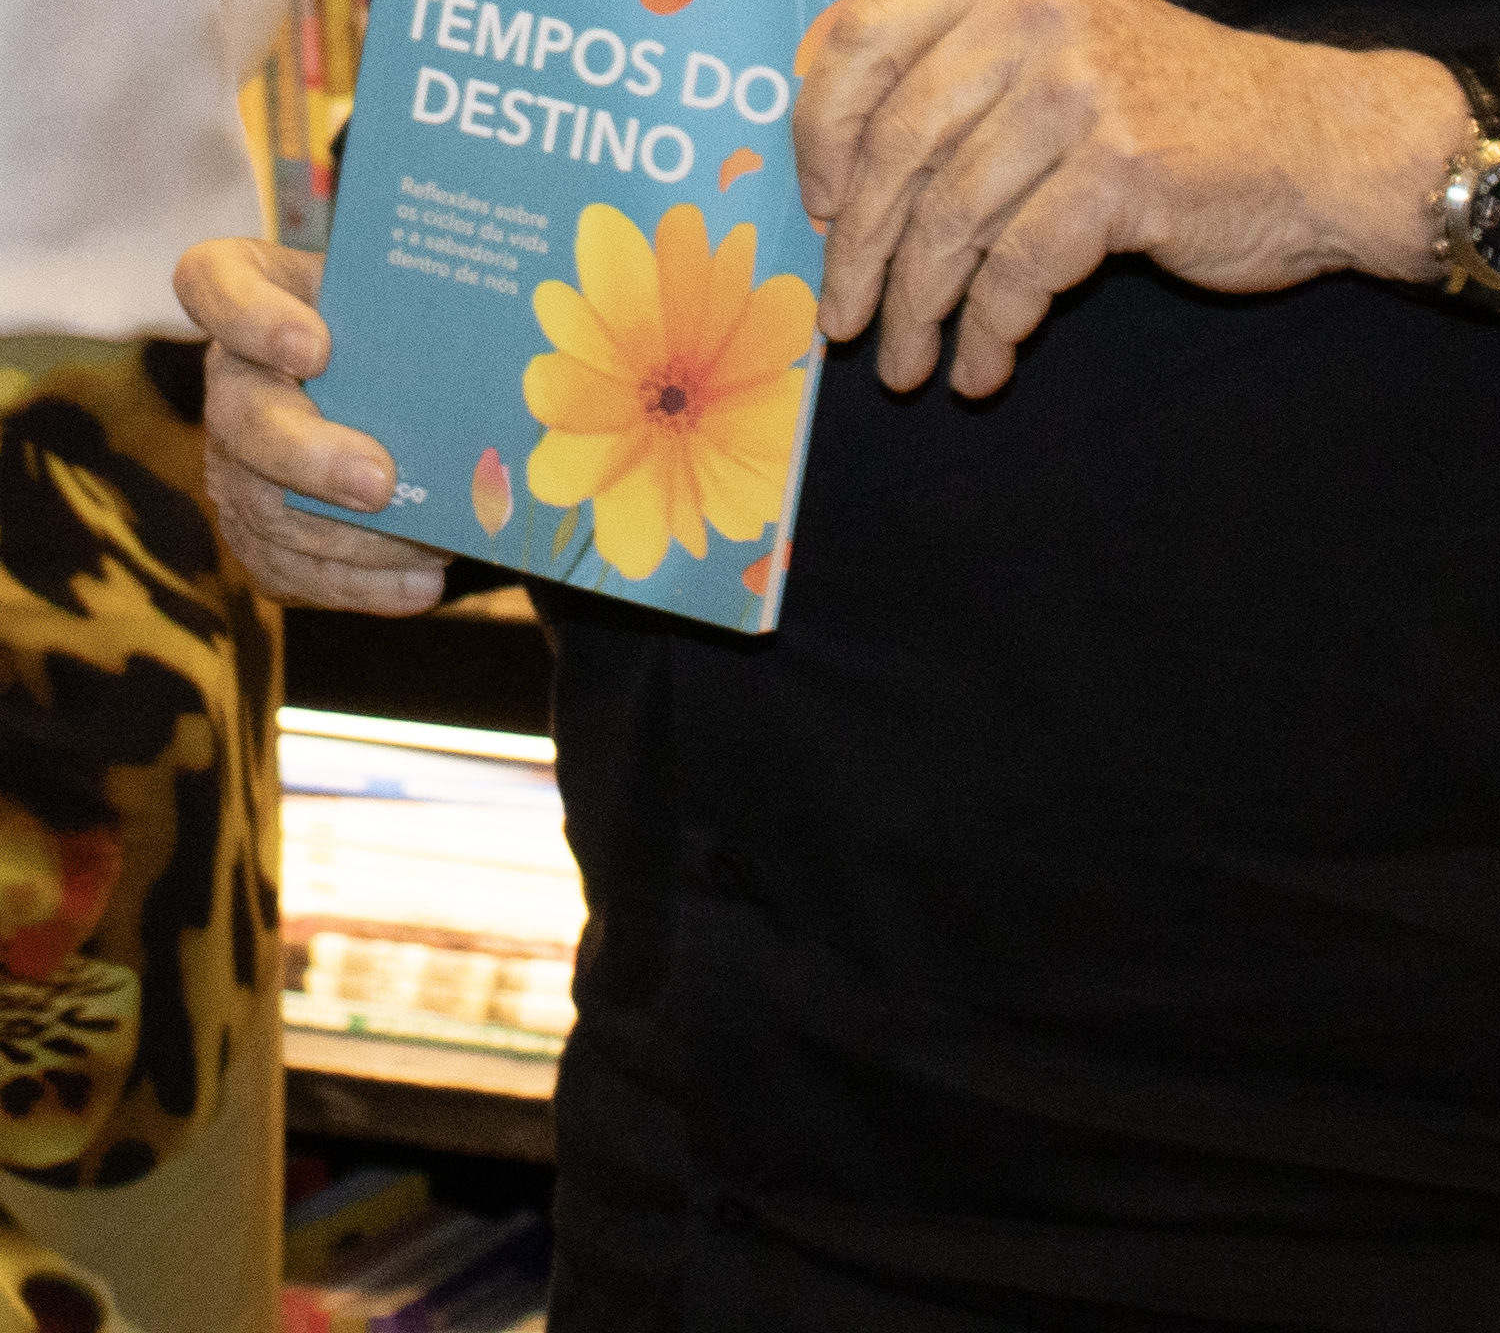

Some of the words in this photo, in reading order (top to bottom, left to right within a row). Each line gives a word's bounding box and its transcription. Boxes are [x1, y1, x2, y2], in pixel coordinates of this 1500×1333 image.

[680, 51, 790, 124] DO
[412, 66, 695, 183] DESTINO
[401, 175, 490, 215] Reflexões
[494, 204, 549, 229] sobre
[391, 227, 404, 242] e
[408, 231, 421, 246] a
[424, 235, 519, 272] sabedoria
[396, 204, 418, 222] os
[422, 210, 475, 235] ciclos
[478, 222, 504, 244] da
[508, 231, 549, 255] vida
[387, 246, 450, 278] dentro
[454, 264, 479, 285] de
[484, 273, 519, 296] nós
